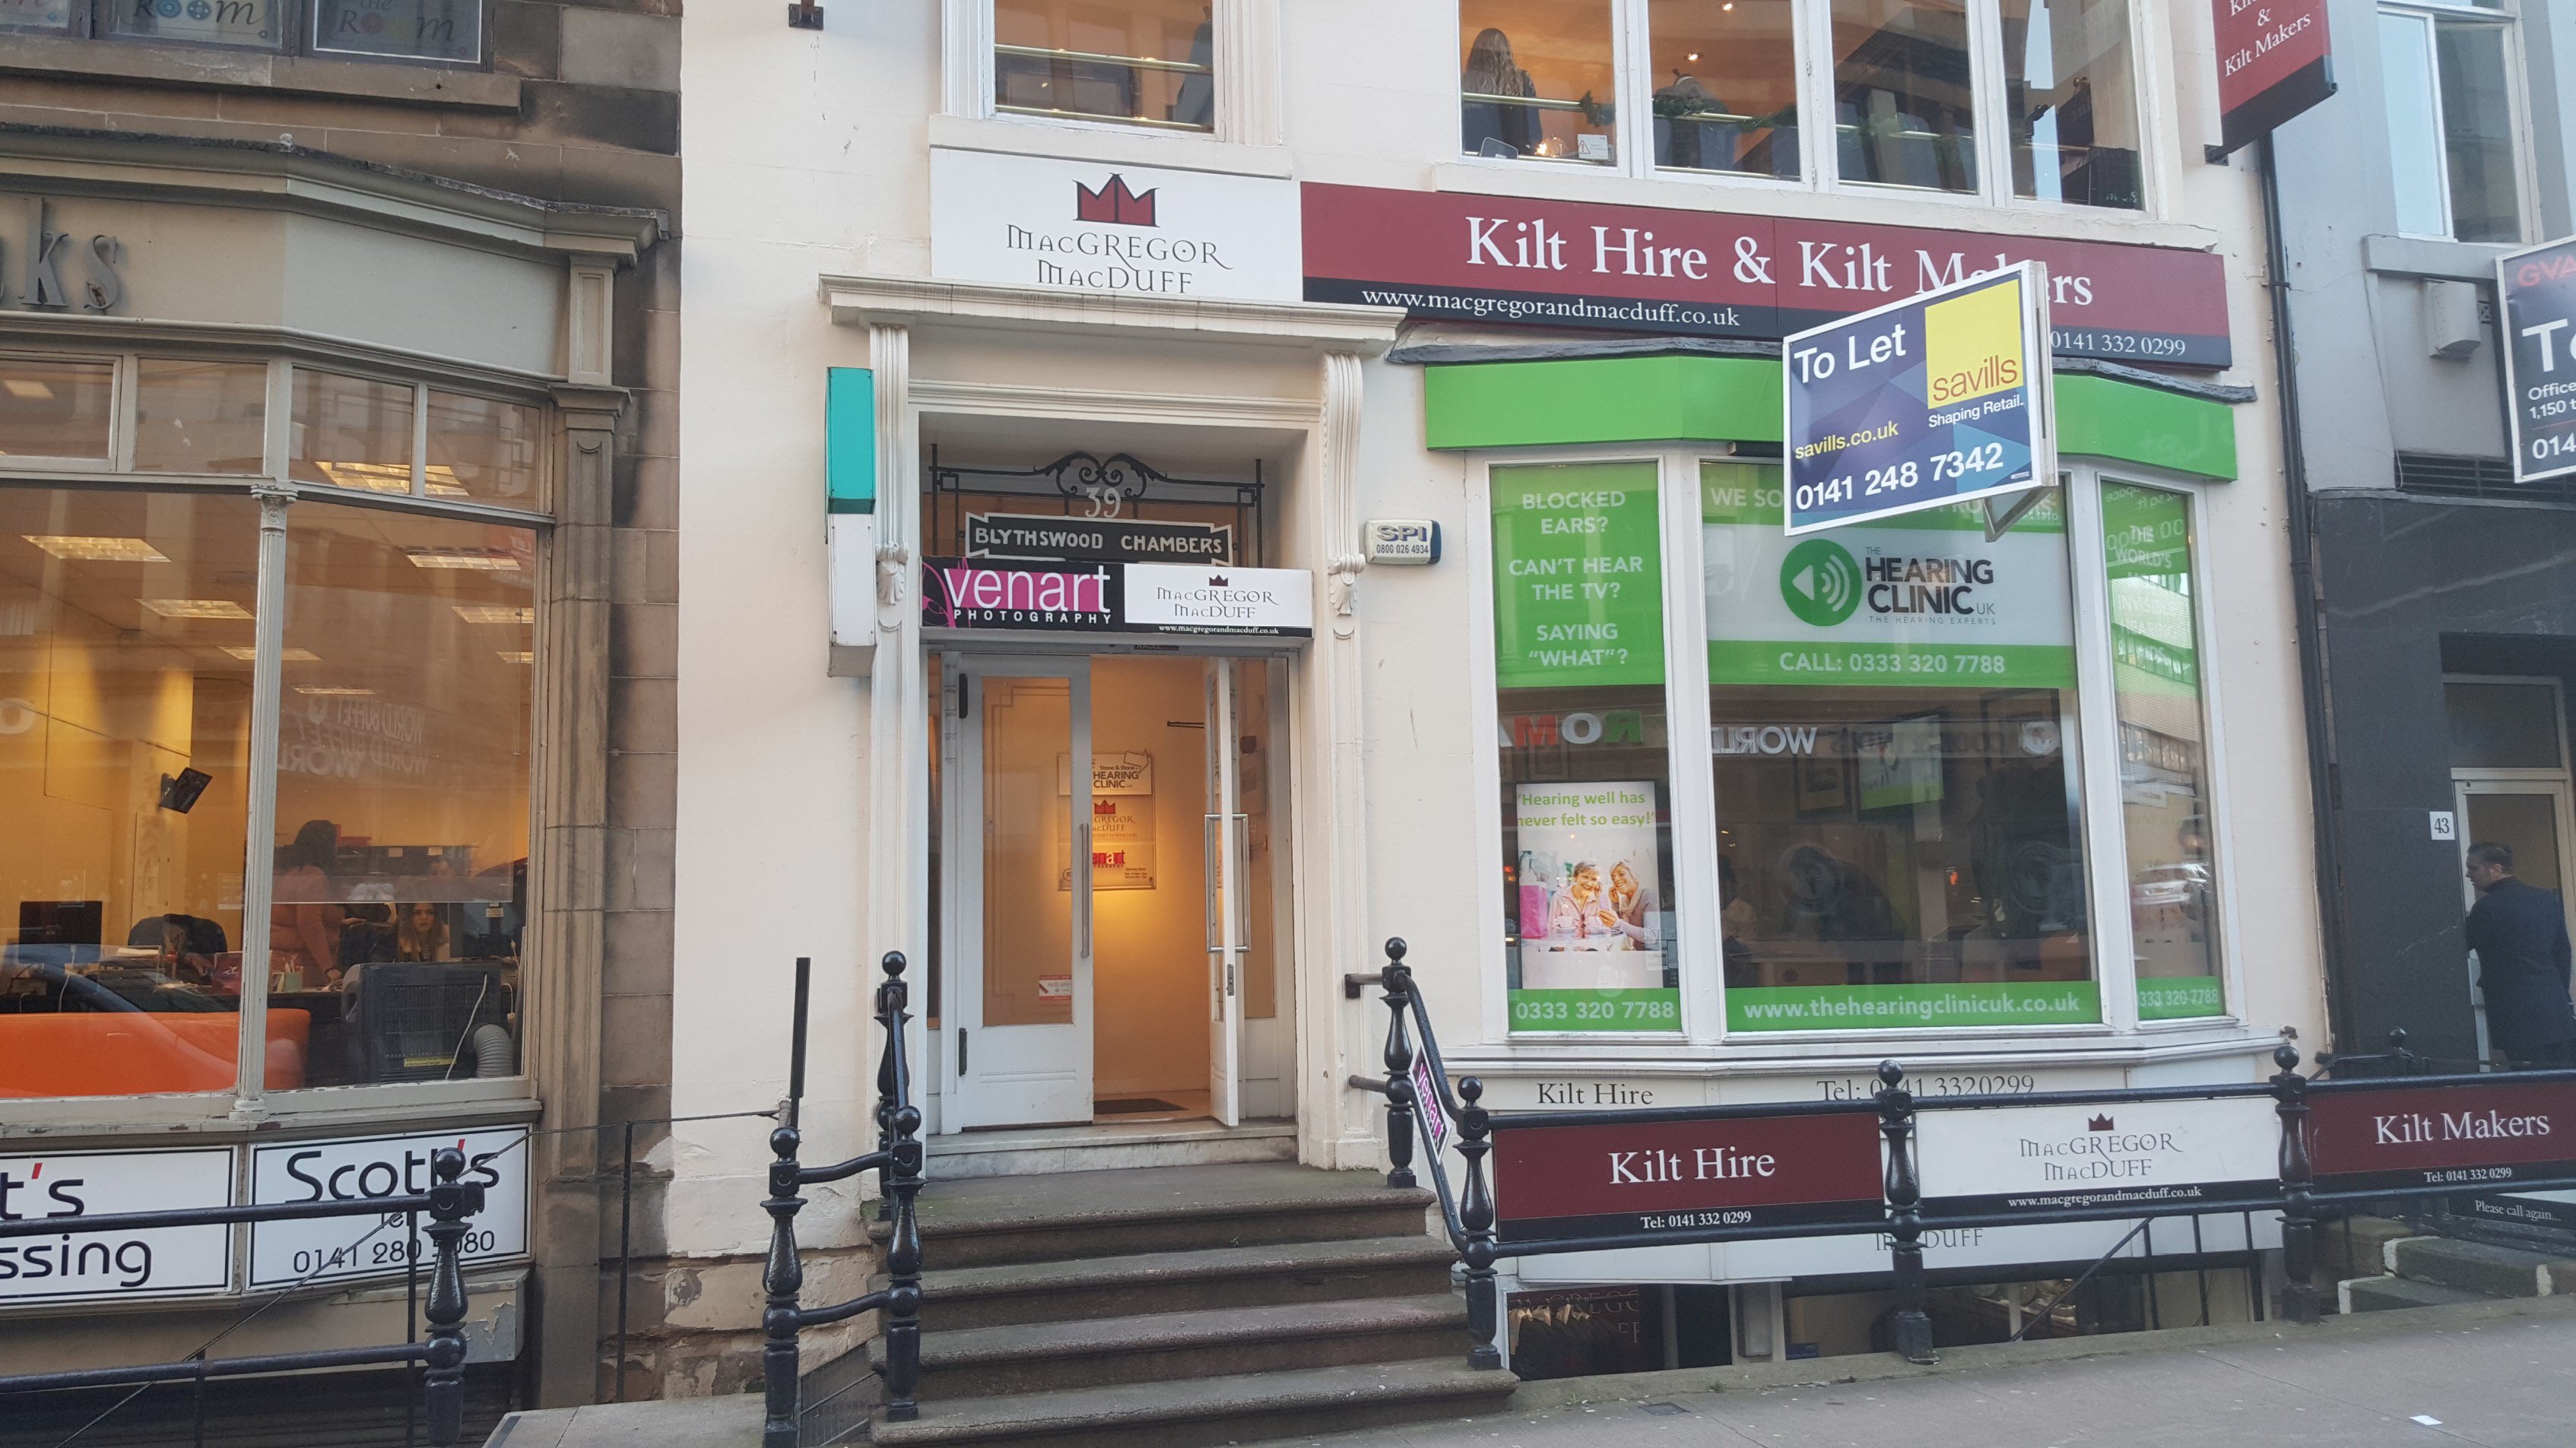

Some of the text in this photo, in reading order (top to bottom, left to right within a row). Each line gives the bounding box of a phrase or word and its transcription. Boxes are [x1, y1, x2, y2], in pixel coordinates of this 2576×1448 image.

[2257, 8, 2270, 27] &
[2225, 14, 2311, 77] Kilt Makers
[0, 198, 119, 310] ks
[1466, 216, 1568, 271] Kilt
[1591, 225, 1708, 280] Hire
[1733, 236, 1776, 285] &
[1797, 241, 1892, 293] Kilt
[1362, 290, 1740, 328] www.macgregorandmacduff.co.uk
[1794, 324, 1907, 384] To Let
[2050, 331, 2187, 356] 0141 332 0299
[2522, 318, 2576, 372] T
[1933, 355, 2018, 401] savills
[1928, 395, 2024, 428] Shaping Retail.
[2530, 400, 2566, 420] 1,150
[1795, 420, 1899, 460] savills.co.uk
[2533, 432, 2576, 459] 014
[1796, 442, 2003, 510] 0141 248 7342
[1085, 487, 1121, 518] 39
[1523, 491, 1626, 510] BLOCKED
[1711, 488, 1746, 506] WE
[1376, 525, 1427, 541] SPI
[1541, 517, 1609, 534] EARS?
[976, 528, 1222, 554] BLYTHSWOOD CHAMBERS
[1376, 544, 1429, 554] 0800 026 4934
[1508, 556, 1643, 576] CAN'T HEAR
[1866, 557, 1994, 585] HEARING
[943, 565, 1111, 613] venart
[1531, 582, 1621, 600] THE TV?
[1868, 584, 1996, 615] CLINIC UK
[953, 610, 1112, 624] PHOTOGRAPHY
[1159, 625, 1279, 635] www.macgregorandmacduff.co.uk
[1536, 623, 1619, 642] SAYING
[1780, 652, 2006, 673] CALL: 0333 320 7788
[1093, 771, 1139, 779] HEARING
[1585, 791, 1615, 804] well
[1620, 791, 1645, 803] has
[1561, 813, 1585, 825] felt
[1591, 815, 1607, 825] so
[2435, 818, 2450, 834] 43
[1743, 993, 2080, 1020] www.thehearingclinicuk.co.uk
[2165, 990, 2187, 1006] 320
[2190, 988, 2218, 1004] 7788
[1516, 1001, 1675, 1019] 0333 320 7788
[1537, 1082, 1654, 1105] Kilt Hire
[1817, 1075, 2034, 1100] Tel: 041 3320299
[2374, 1109, 2550, 1145] Kilt Makers
[1608, 1145, 1775, 1184] Kilt Hire
[2424, 1167, 2512, 1183] Tel: 0141 332 0299
[2008, 1187, 2202, 1208] www.macgregorandmacduff.co.uk
[2476, 1200, 2505, 1215] Please
[2507, 1205, 2524, 1217] call
[1640, 1210, 1752, 1230] Tel: 0141 332 0299
[293, 1247, 357, 1273] 0141
